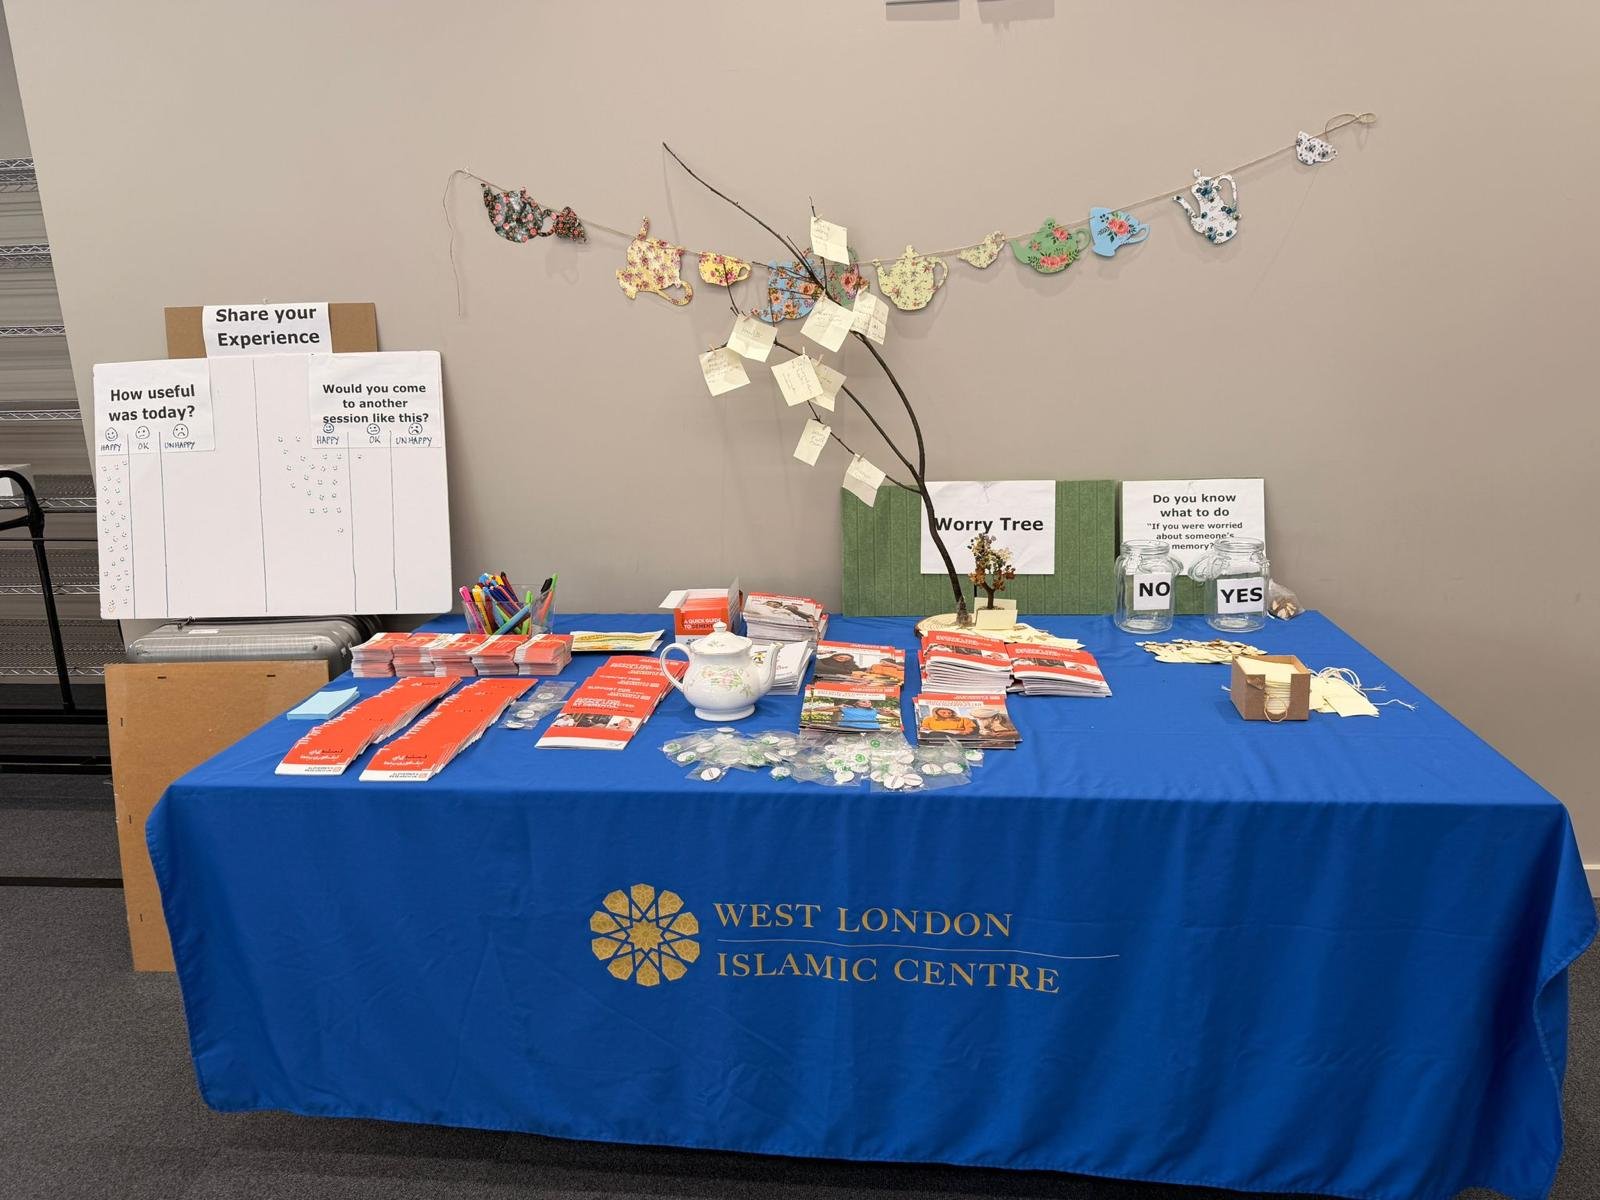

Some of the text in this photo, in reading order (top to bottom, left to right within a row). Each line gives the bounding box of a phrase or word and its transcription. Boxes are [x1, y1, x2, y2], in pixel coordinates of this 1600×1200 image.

[215, 308, 317, 324] Share your
[217, 331, 320, 349] Experience
[110, 384, 195, 402] How useful
[322, 384, 426, 395] Would you come
[342, 399, 408, 408] to another
[108, 405, 195, 421] was today?
[323, 413, 429, 424] session like this?
[316, 435, 340, 445] HAPPY
[368, 435, 381, 444] OK
[395, 436, 433, 448] UNHAPPY
[101, 443, 122, 452] HAPPY
[137, 442, 150, 450] OK
[164, 441, 196, 450] UNHAPPY
[1153, 494, 1237, 505] Do you know
[1159, 507, 1230, 517] what to do
[934, 517, 1044, 534] Worry Tree
[1162, 523, 1179, 531] you
[1171, 542, 1215, 550] memory?
[1139, 581, 1171, 597] NO
[1220, 587, 1263, 603] YES
[712, 903, 1013, 937] WEST LONDON
[717, 953, 1060, 994] ISLAMIC CENTRE
